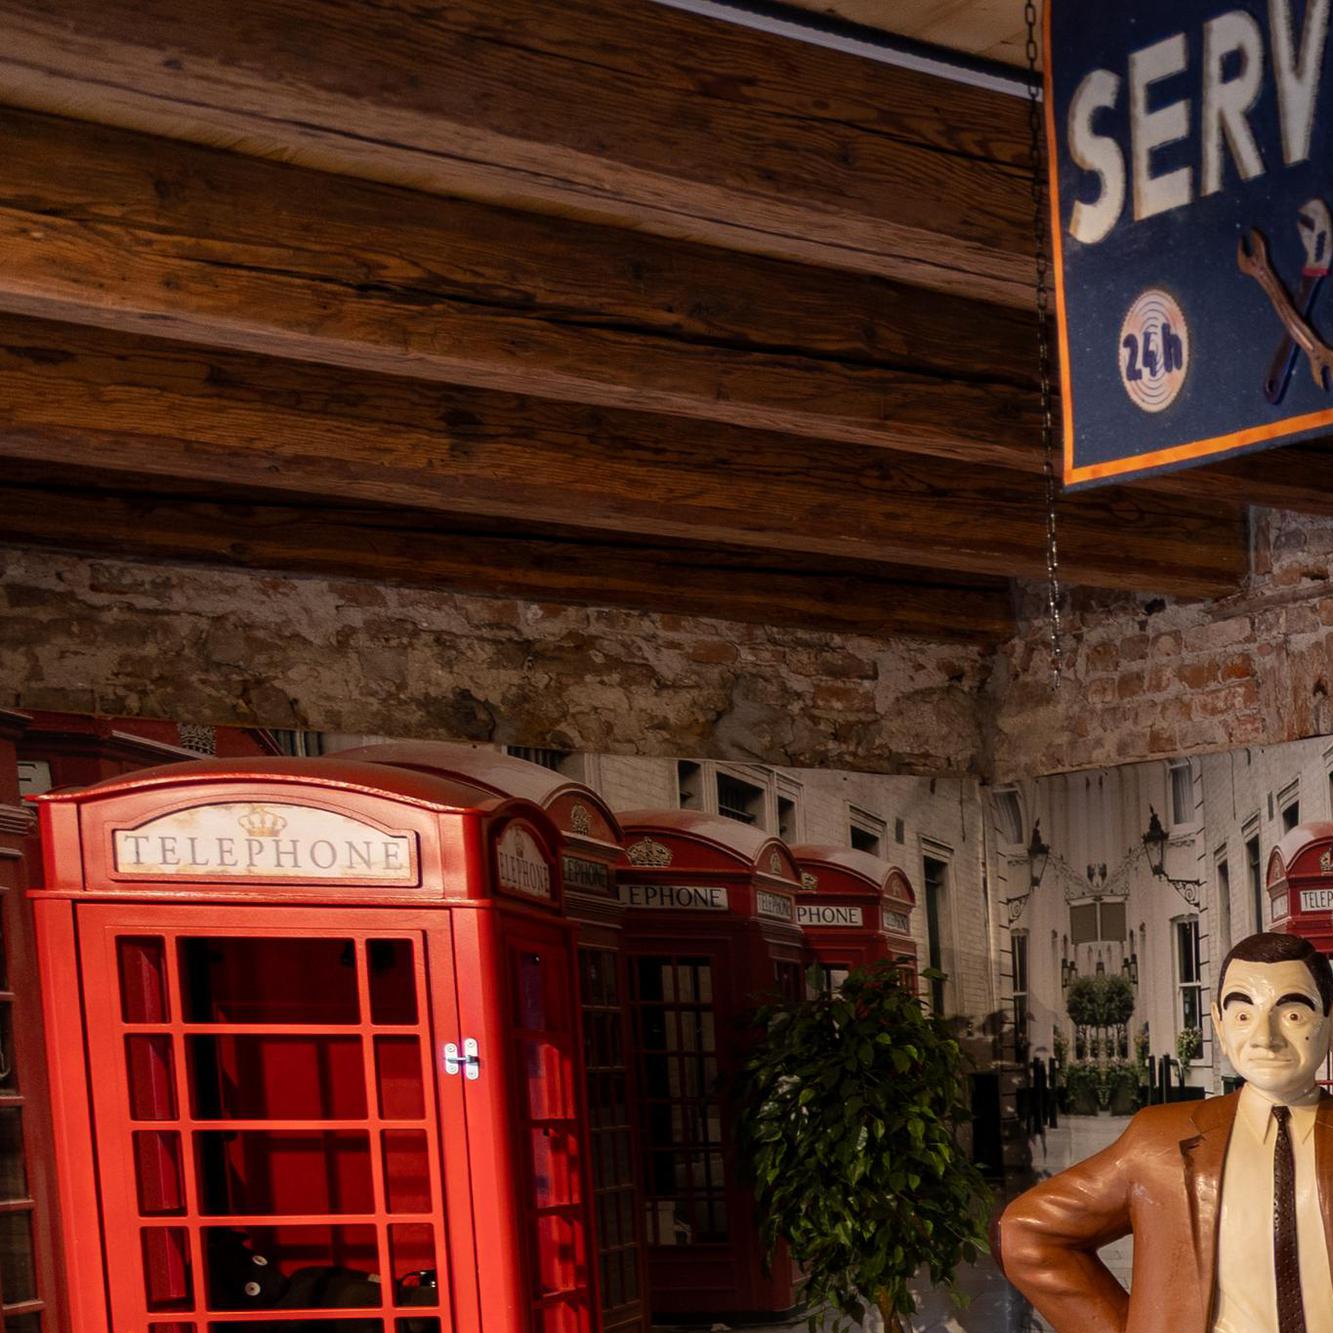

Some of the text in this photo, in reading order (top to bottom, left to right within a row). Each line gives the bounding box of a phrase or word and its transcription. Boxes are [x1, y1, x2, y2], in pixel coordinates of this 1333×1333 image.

[1122, 322, 1183, 381] 24h
[124, 835, 404, 871] TELEPHONE
[797, 906, 858, 923] PHONE
